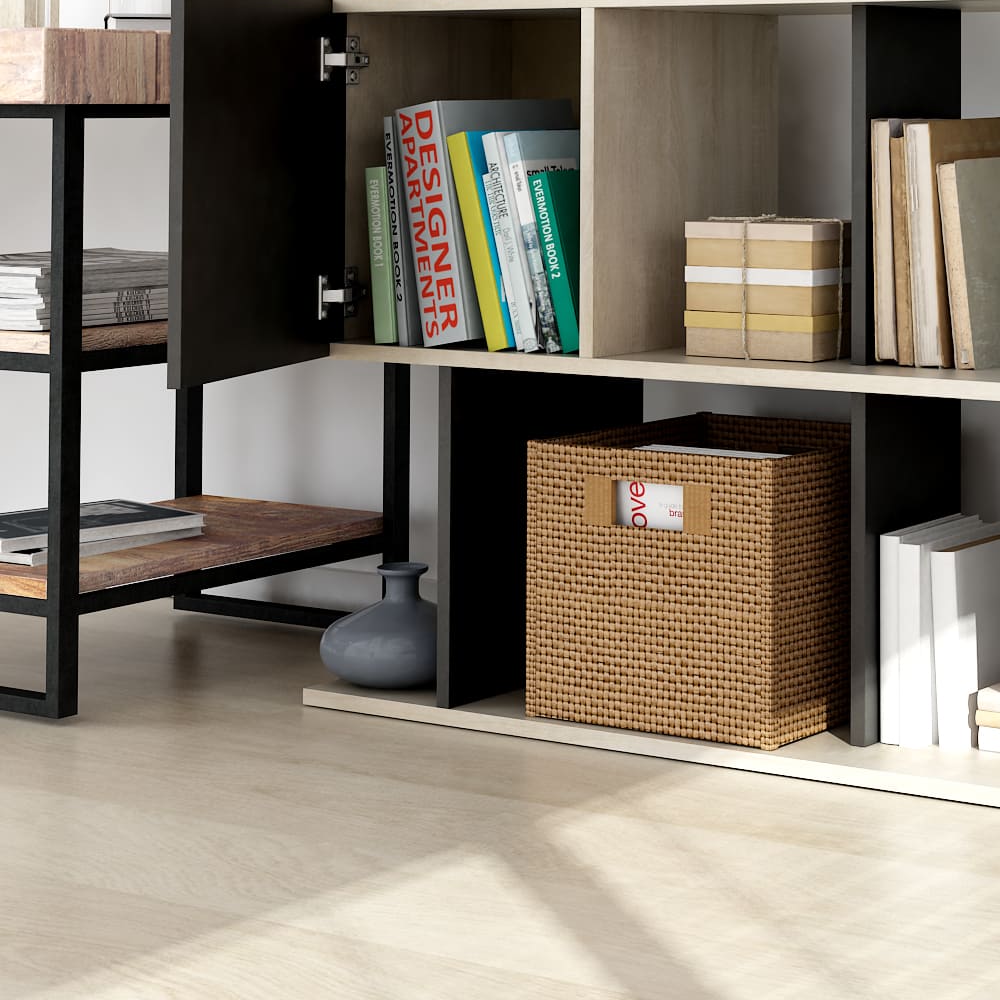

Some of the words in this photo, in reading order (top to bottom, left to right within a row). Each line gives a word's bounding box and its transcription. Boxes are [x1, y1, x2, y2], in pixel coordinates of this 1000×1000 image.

[369, 179, 382, 233] EVERMOTION
[385, 132, 398, 235] EVERMOTION
[392, 241, 402, 287] BOOK
[488, 162, 509, 219] ARCHITECTURE
[533, 178, 556, 242] EVERMOTION
[399, 112, 440, 339] APARTMENTS
[414, 109, 458, 331] DESIGNER
[372, 236, 384, 261] BOOK
[544, 243, 560, 271] BOOK
[551, 271, 561, 279] 2
[669, 509, 683, 518] bra
